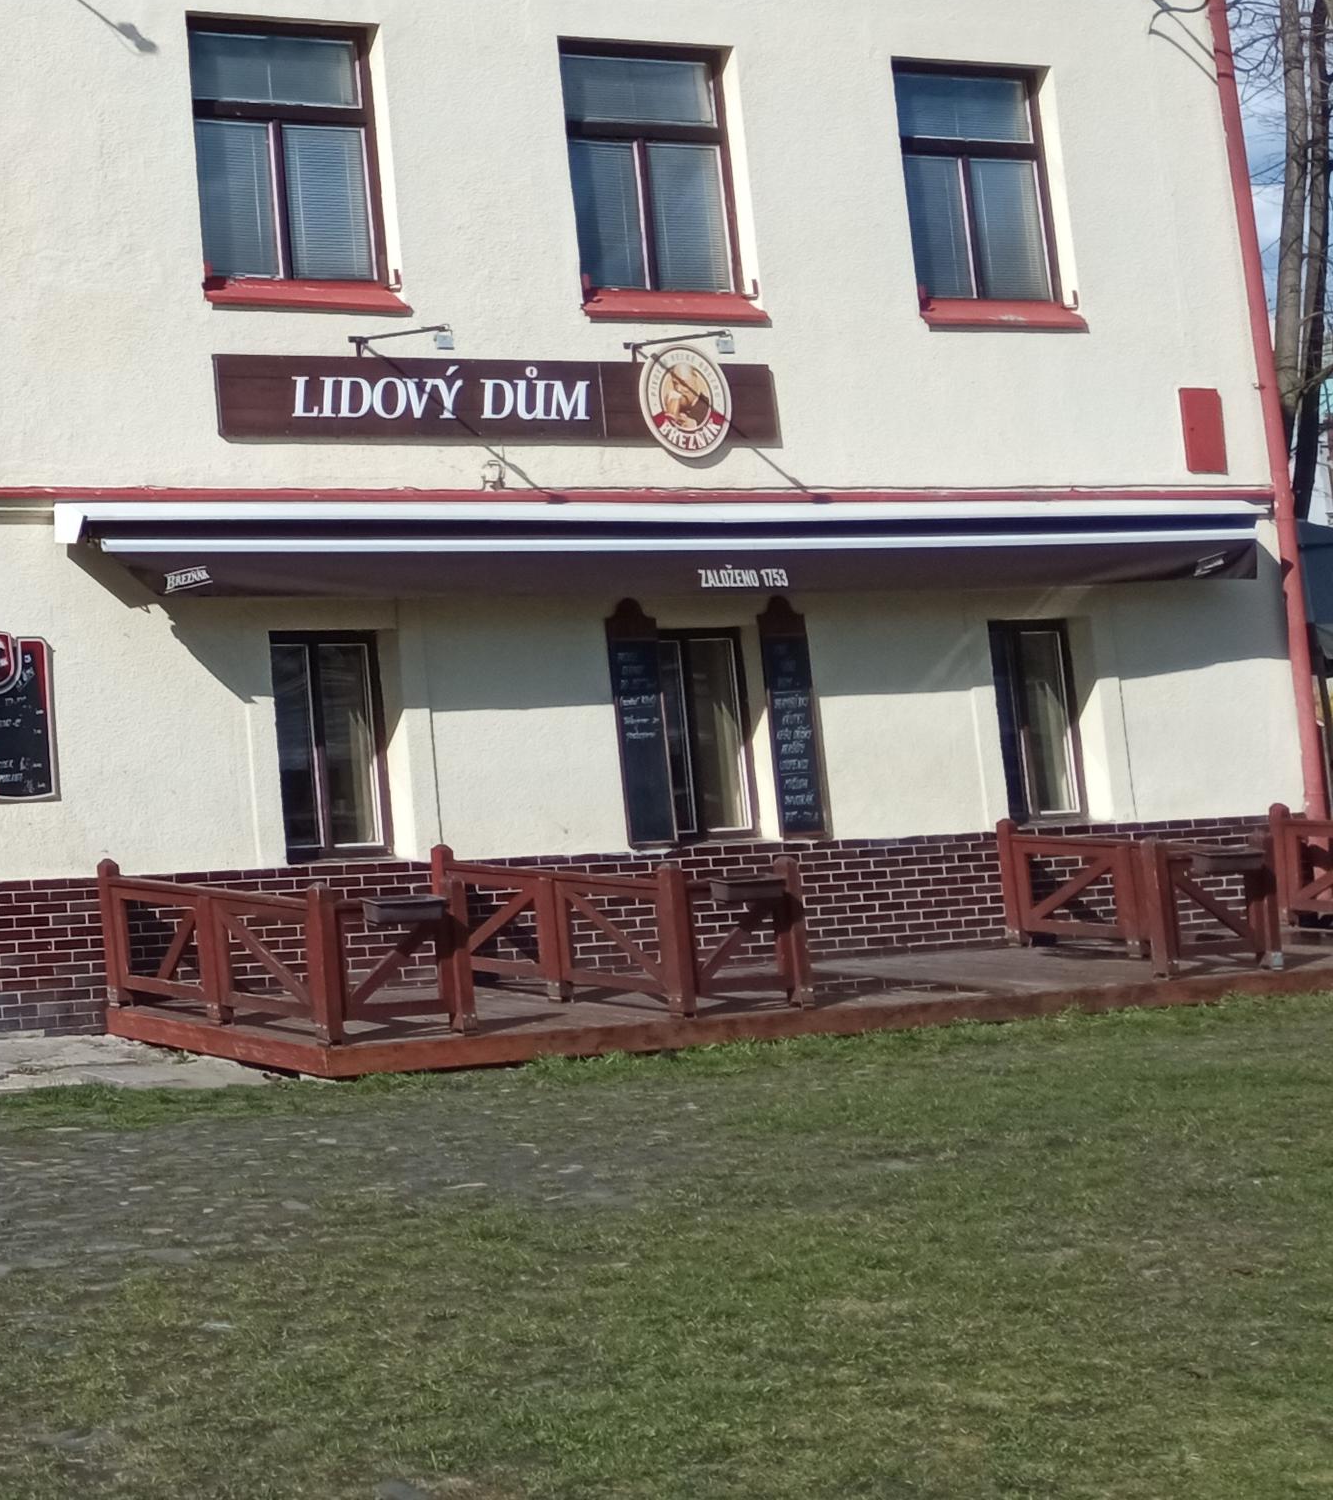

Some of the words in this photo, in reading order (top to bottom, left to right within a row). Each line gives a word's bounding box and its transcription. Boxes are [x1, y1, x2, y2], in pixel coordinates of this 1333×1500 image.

[291, 365, 463, 419] LIDOVÝ
[480, 366, 590, 420] DŮM
[697, 564, 760, 588] ZALOŽENO
[760, 568, 789, 587] 1753
